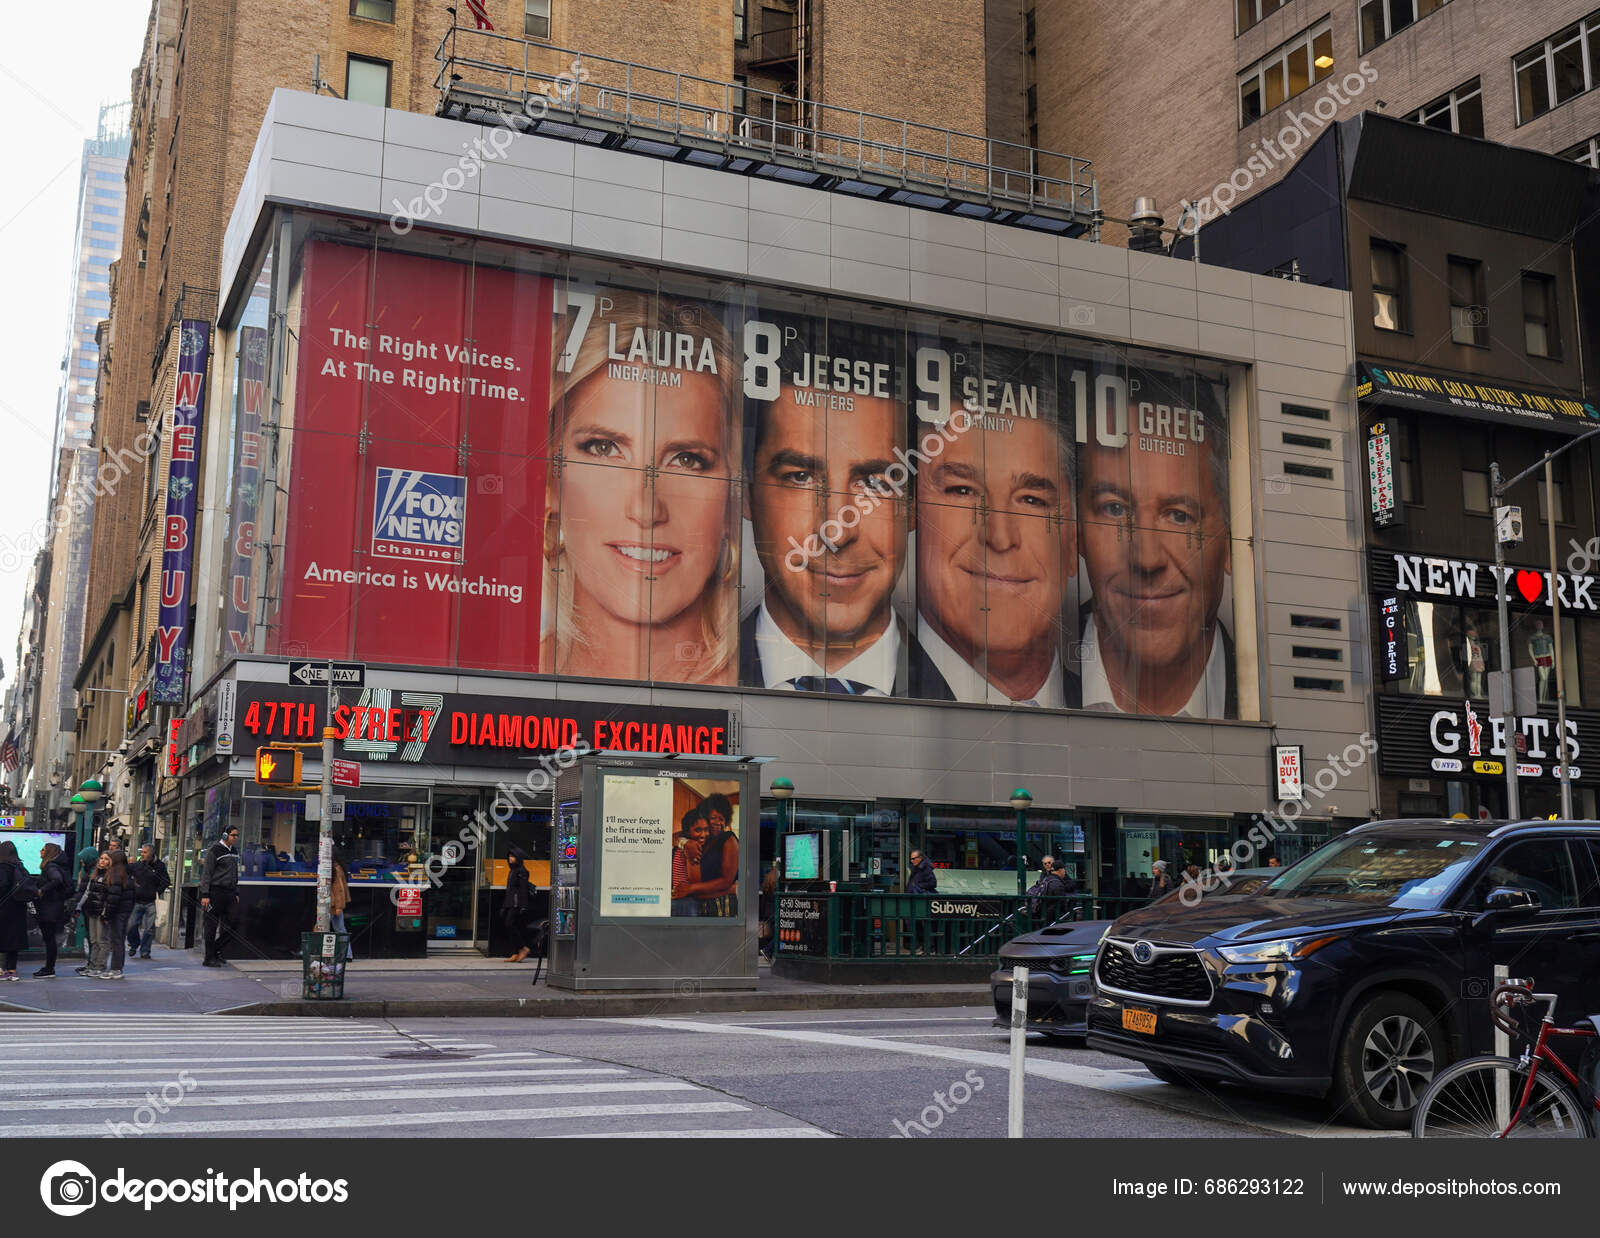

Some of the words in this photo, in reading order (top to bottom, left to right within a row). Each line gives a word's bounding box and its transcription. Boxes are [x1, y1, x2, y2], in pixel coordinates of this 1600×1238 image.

[553, 293, 596, 374] 7
[329, 327, 371, 351] The
[378, 334, 437, 362] Right
[443, 345, 522, 372] Voices.
[607, 322, 719, 376] LAURA
[743, 320, 782, 403] 8
[321, 357, 348, 379] At
[353, 361, 395, 386] The
[402, 368, 462, 395] Right
[467, 376, 526, 402] Time.
[607, 363, 682, 389] INGRAHAM
[793, 351, 891, 400] JESSE
[916, 346, 952, 424] 9
[793, 389, 855, 412] WATTERS
[962, 376, 1038, 419] SEAN
[1384, 369, 1444, 395] MIDTOWN
[1442, 379, 1477, 400] GOLD
[1520, 392, 1559, 413] PAWN
[1553, 398, 1587, 418] SHOP
[170, 371, 204, 462] WE
[1070, 369, 1128, 450] 10
[1449, 397, 1464, 406] WE
[1464, 400, 1480, 409] BUY
[1481, 402, 1504, 412] GOLD
[1512, 407, 1555, 420] DIAMONDS
[1138, 401, 1206, 444] GREG
[1138, 436, 1186, 458] GUTFELD
[405, 491, 464, 518] FOX
[386, 514, 463, 543] NEWS
[376, 543, 462, 562] channel
[158, 514, 189, 664] BUY
[303, 561, 396, 588] America
[402, 569, 419, 590] is
[424, 571, 524, 603] Watching
[1394, 554, 1479, 598] NEW
[1383, 597, 1397, 607] NEW
[300, 668, 323, 680] ONE
[333, 670, 356, 681] WAY
[244, 700, 316, 738] 47TH
[333, 704, 435, 743] STREET
[450, 711, 579, 751] DIAMOND
[594, 719, 725, 756] EXCHANGE
[657, 770, 689, 778] JCDecaux
[1279, 766, 1299, 777] BUY
[1281, 755, 1297, 766] WE
[1521, 765, 1541, 775] FDNY
[605, 826, 618, 834] the
[619, 825, 635, 834] first
[636, 826, 653, 835] time
[654, 827, 667, 835] she
[638, 816, 661, 827] forget
[604, 835, 627, 845] called
[628, 837, 640, 845] me
[1126, 831, 1157, 840] FLAWLESS
[780, 899, 794, 908] 47-50
[930, 900, 978, 917] Subway
